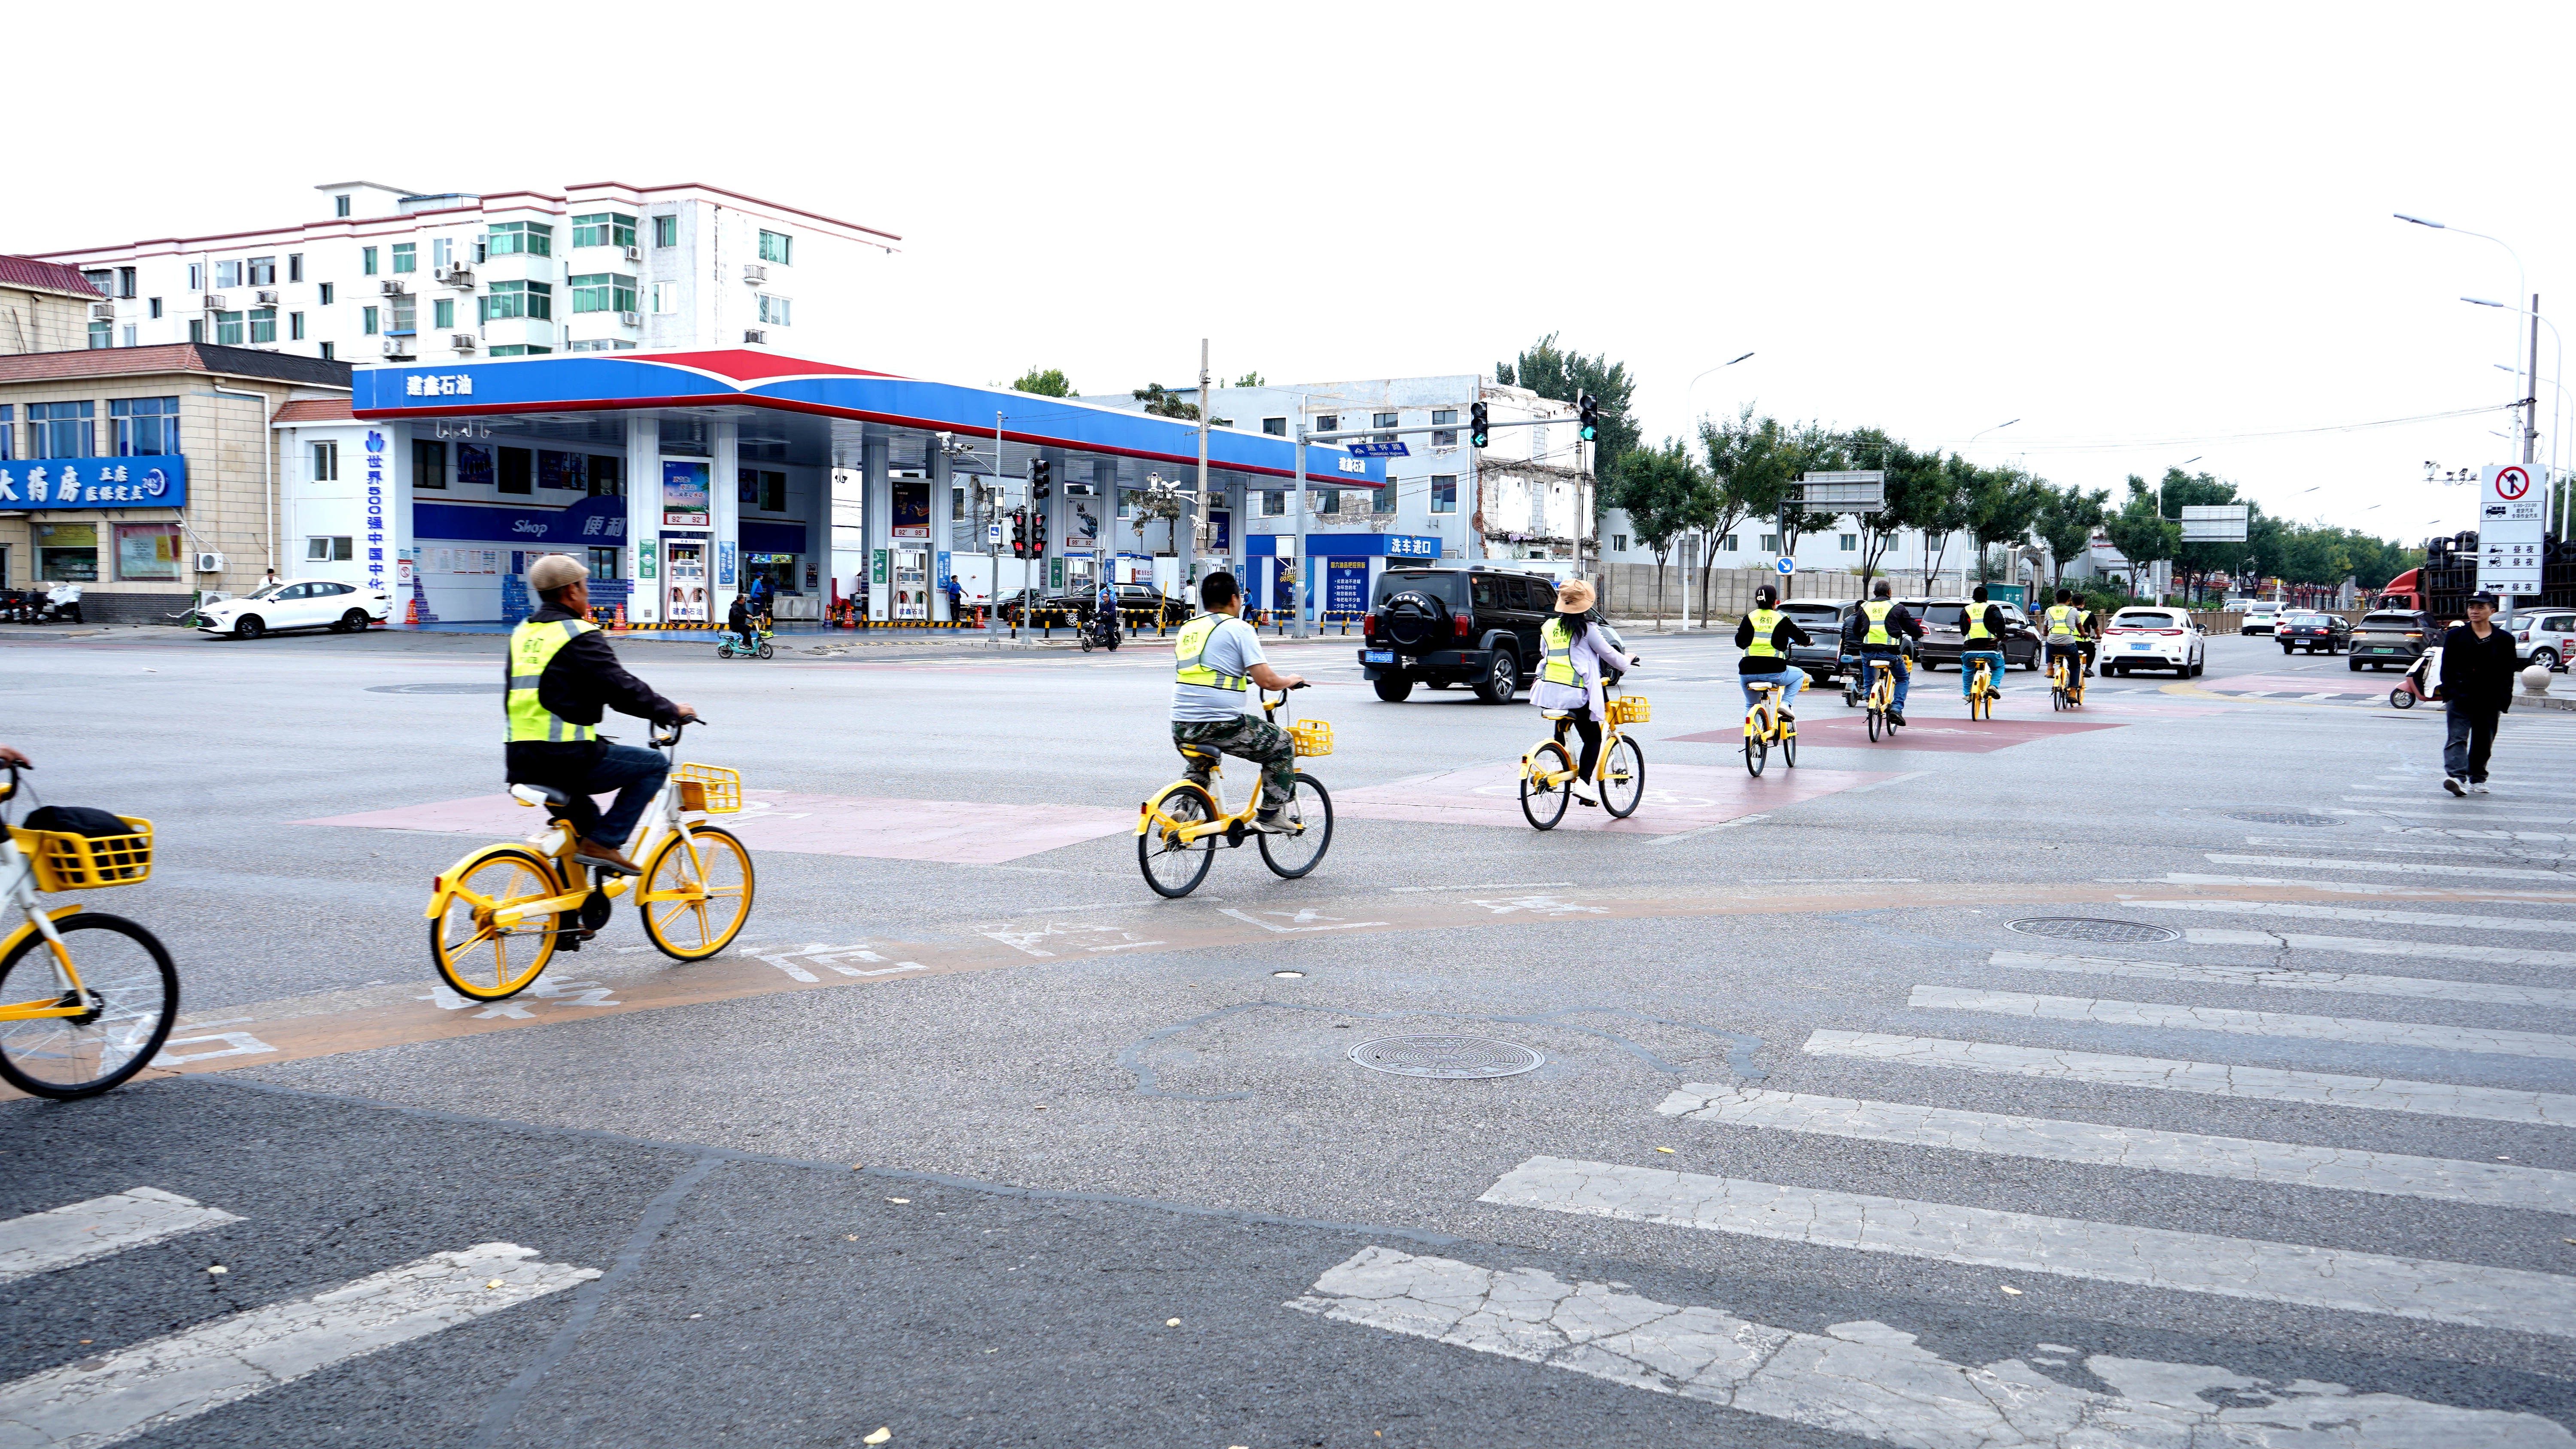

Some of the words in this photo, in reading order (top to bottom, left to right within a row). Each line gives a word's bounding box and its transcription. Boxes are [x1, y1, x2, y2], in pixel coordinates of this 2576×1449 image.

[407, 375, 473, 396] 建鑫石油
[1339, 457, 1366, 473] 建鑫石油
[85, 485, 145, 501] 医保定点
[512, 519, 548, 537] Shop
[582, 515, 627, 537] 便利
[1391, 538, 1431, 554] 洗车进口
[1397, 595, 1425, 606] TANK
